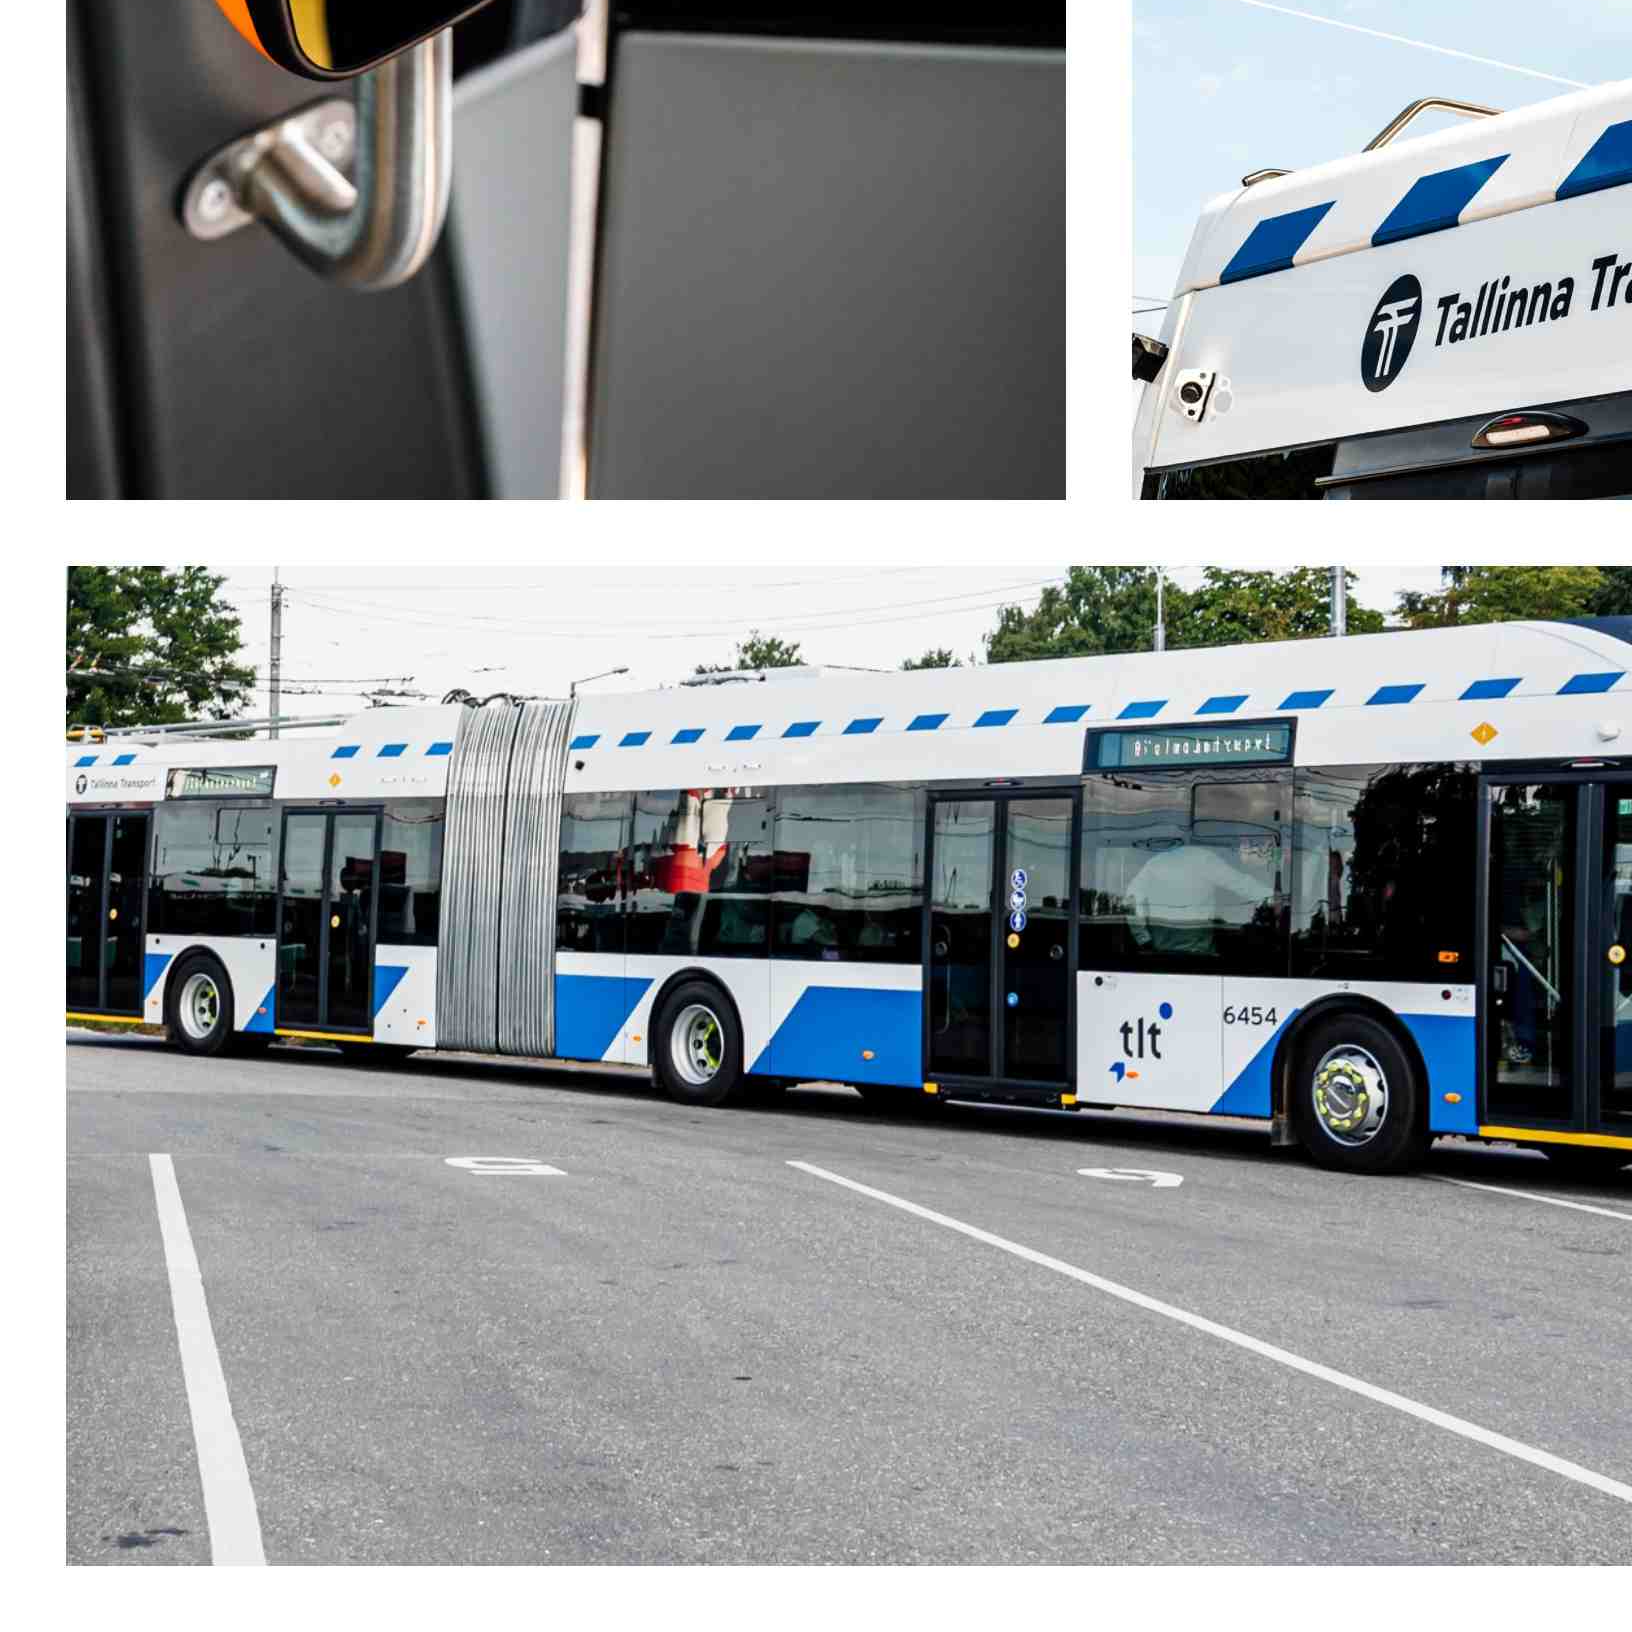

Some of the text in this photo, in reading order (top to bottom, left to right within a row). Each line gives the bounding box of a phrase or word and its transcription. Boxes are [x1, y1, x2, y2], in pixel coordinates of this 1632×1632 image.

[1434, 275, 1575, 347] Tallinna
[1223, 1005, 1278, 1026] 6454
[1119, 1017, 1162, 1060] tlt
